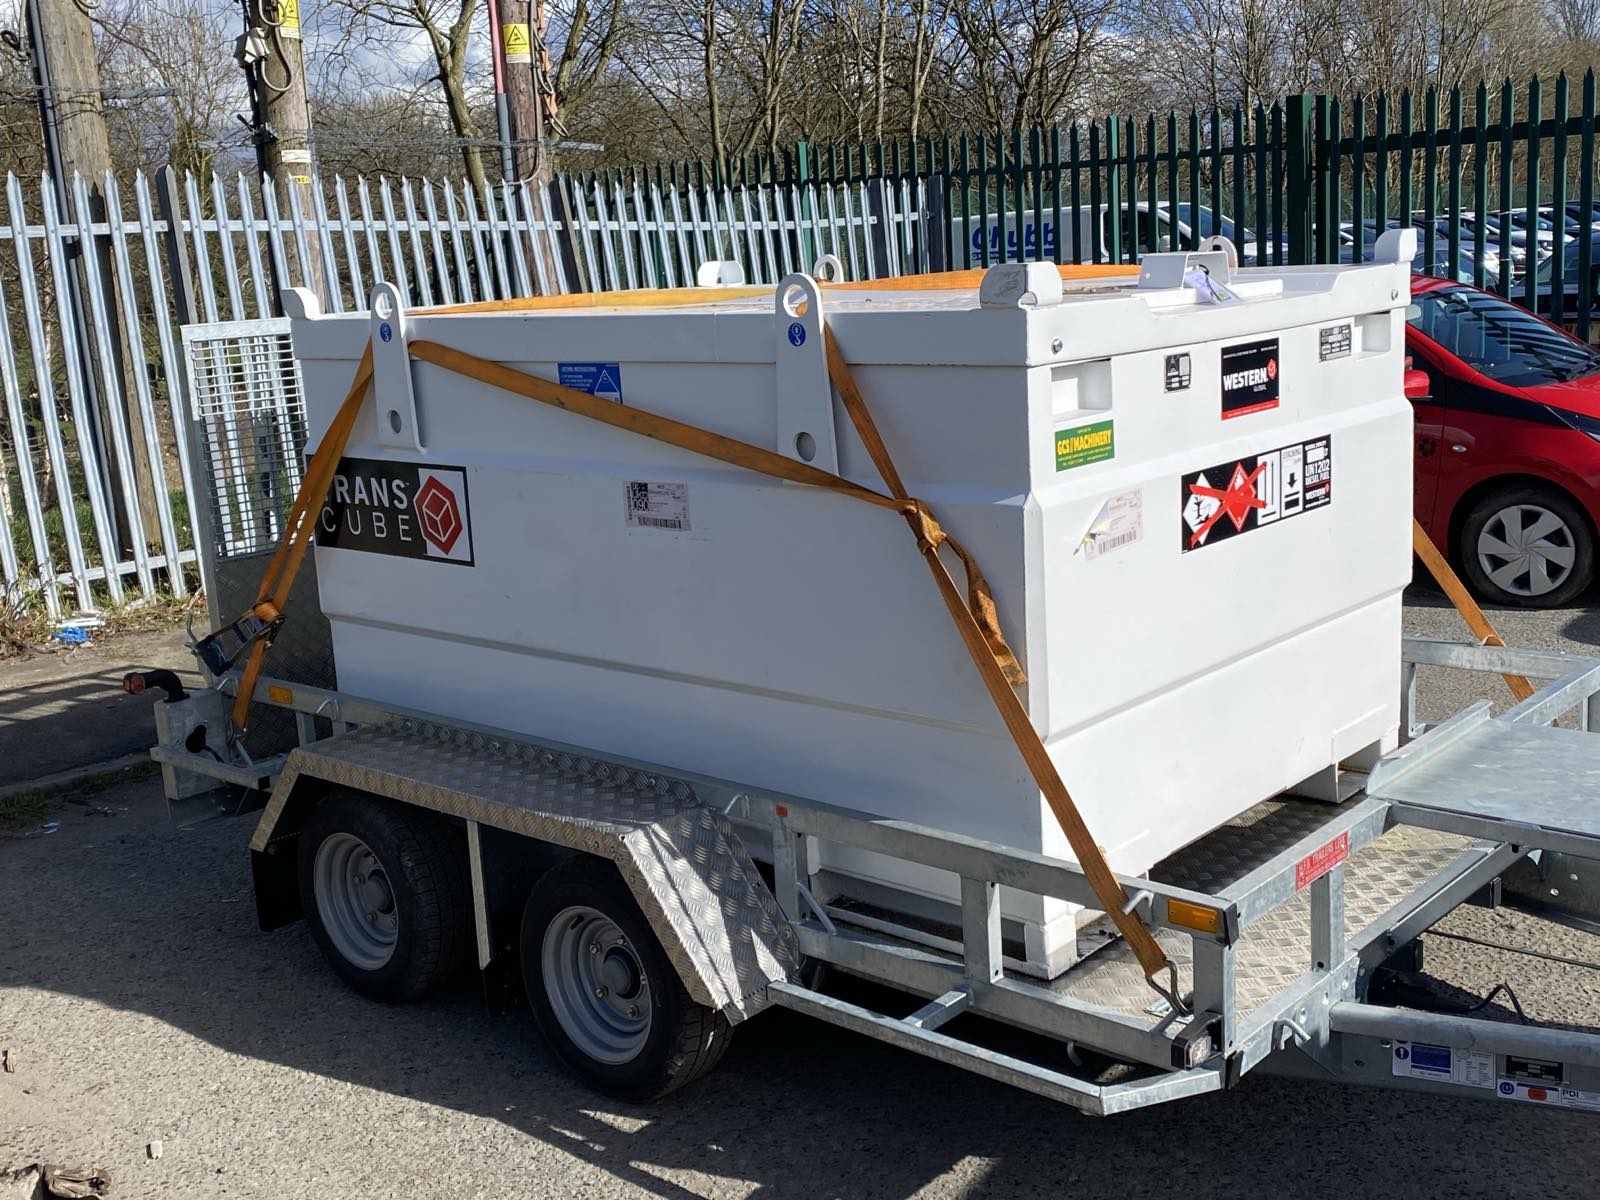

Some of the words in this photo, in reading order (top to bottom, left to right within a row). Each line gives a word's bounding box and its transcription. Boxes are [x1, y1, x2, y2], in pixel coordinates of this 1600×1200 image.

[1305, 458, 1330, 477] UN1202
[324, 475, 408, 510] RANS
[321, 507, 412, 541] CUBE
[1563, 1089, 1579, 1098] PDI
